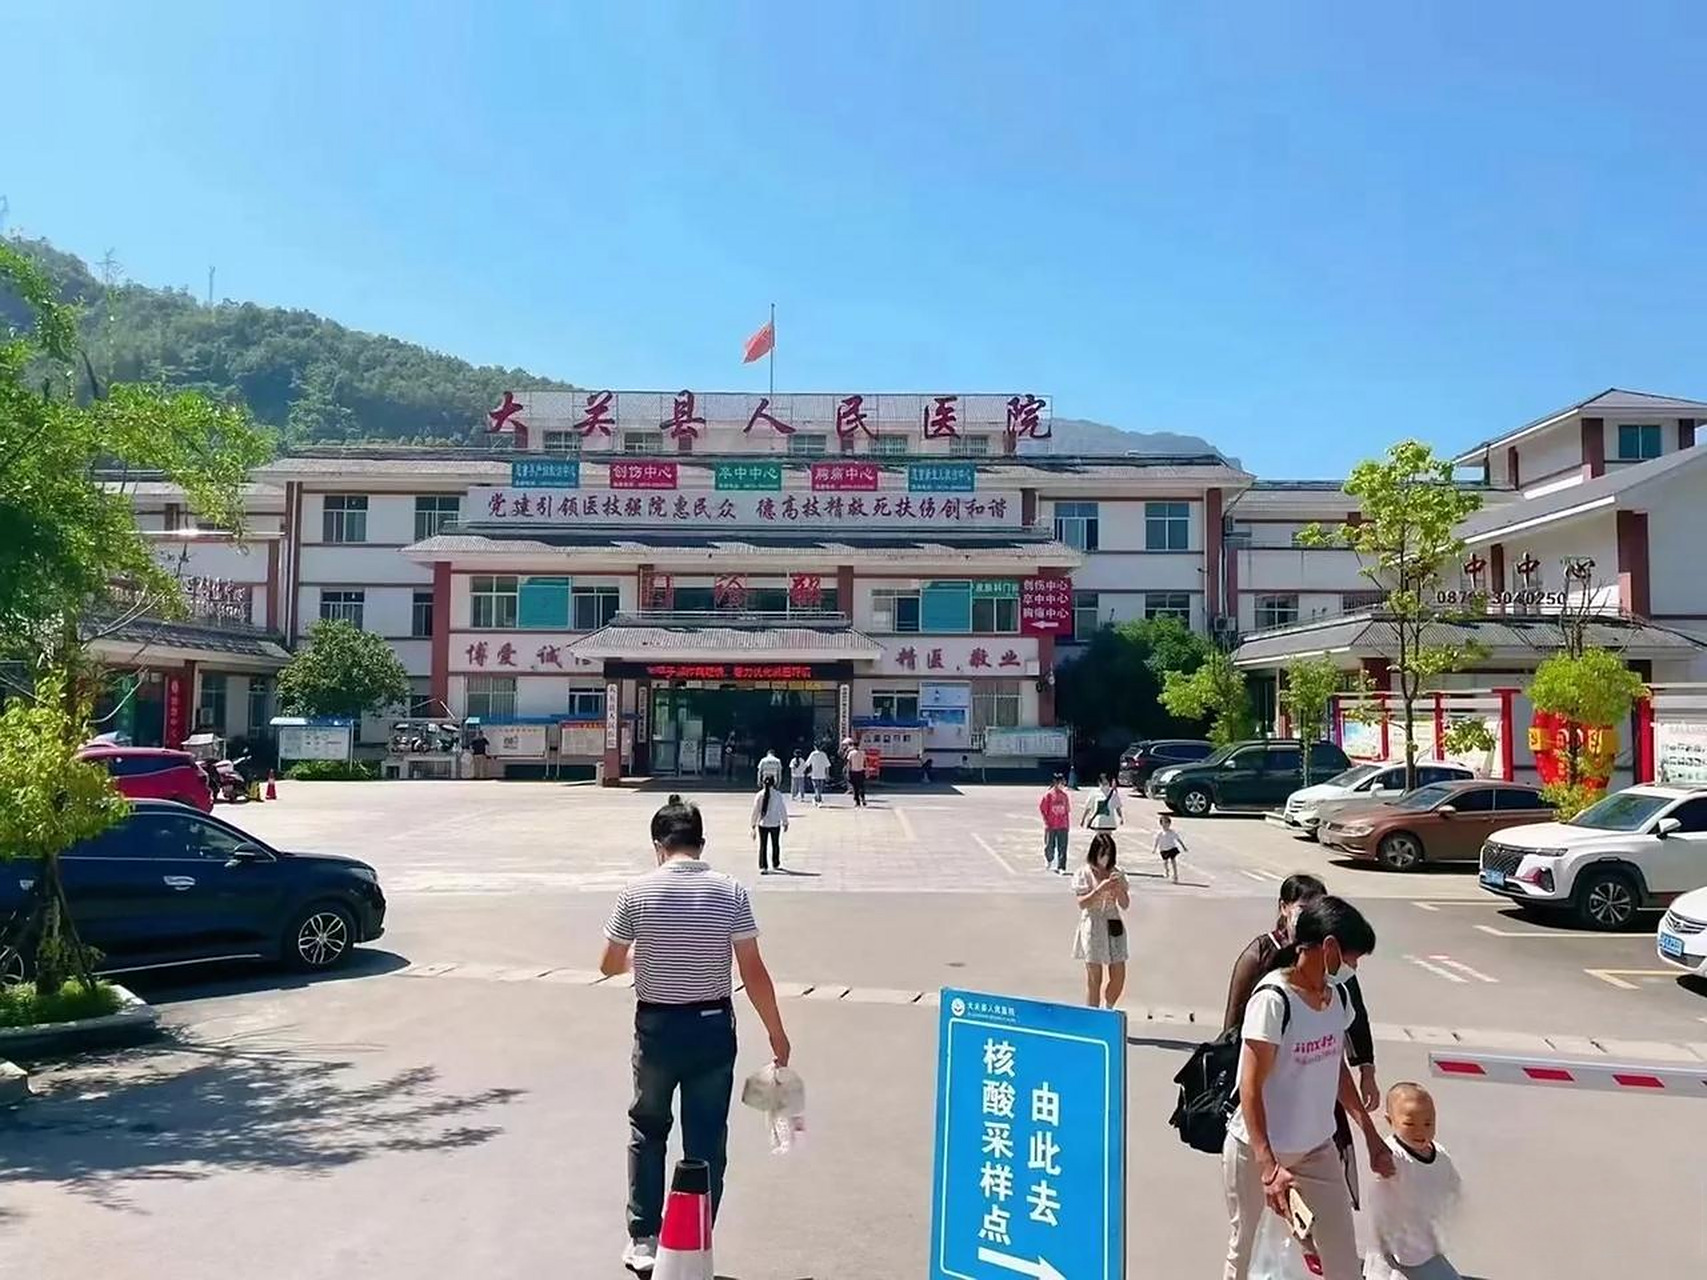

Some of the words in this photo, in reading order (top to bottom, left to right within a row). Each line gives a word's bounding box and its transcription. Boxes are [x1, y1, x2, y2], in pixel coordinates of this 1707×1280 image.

[487, 389, 1053, 440] 大关县人民医院
[613, 465, 673, 478] 创伤中心
[719, 467, 779, 480] 卒中中心
[488, 494, 738, 520] 党建引领医技强院惠民众
[756, 496, 1008, 521] 德高技精救死扶伤创和谐
[1462, 551, 1596, 590] 中中心
[1023, 580, 1069, 591] 创伤中心
[1023, 593, 1069, 604] 卒中中心
[978, 1037, 1017, 1246] 核酸采样点
[1026, 1082, 1061, 1228] 由此去
